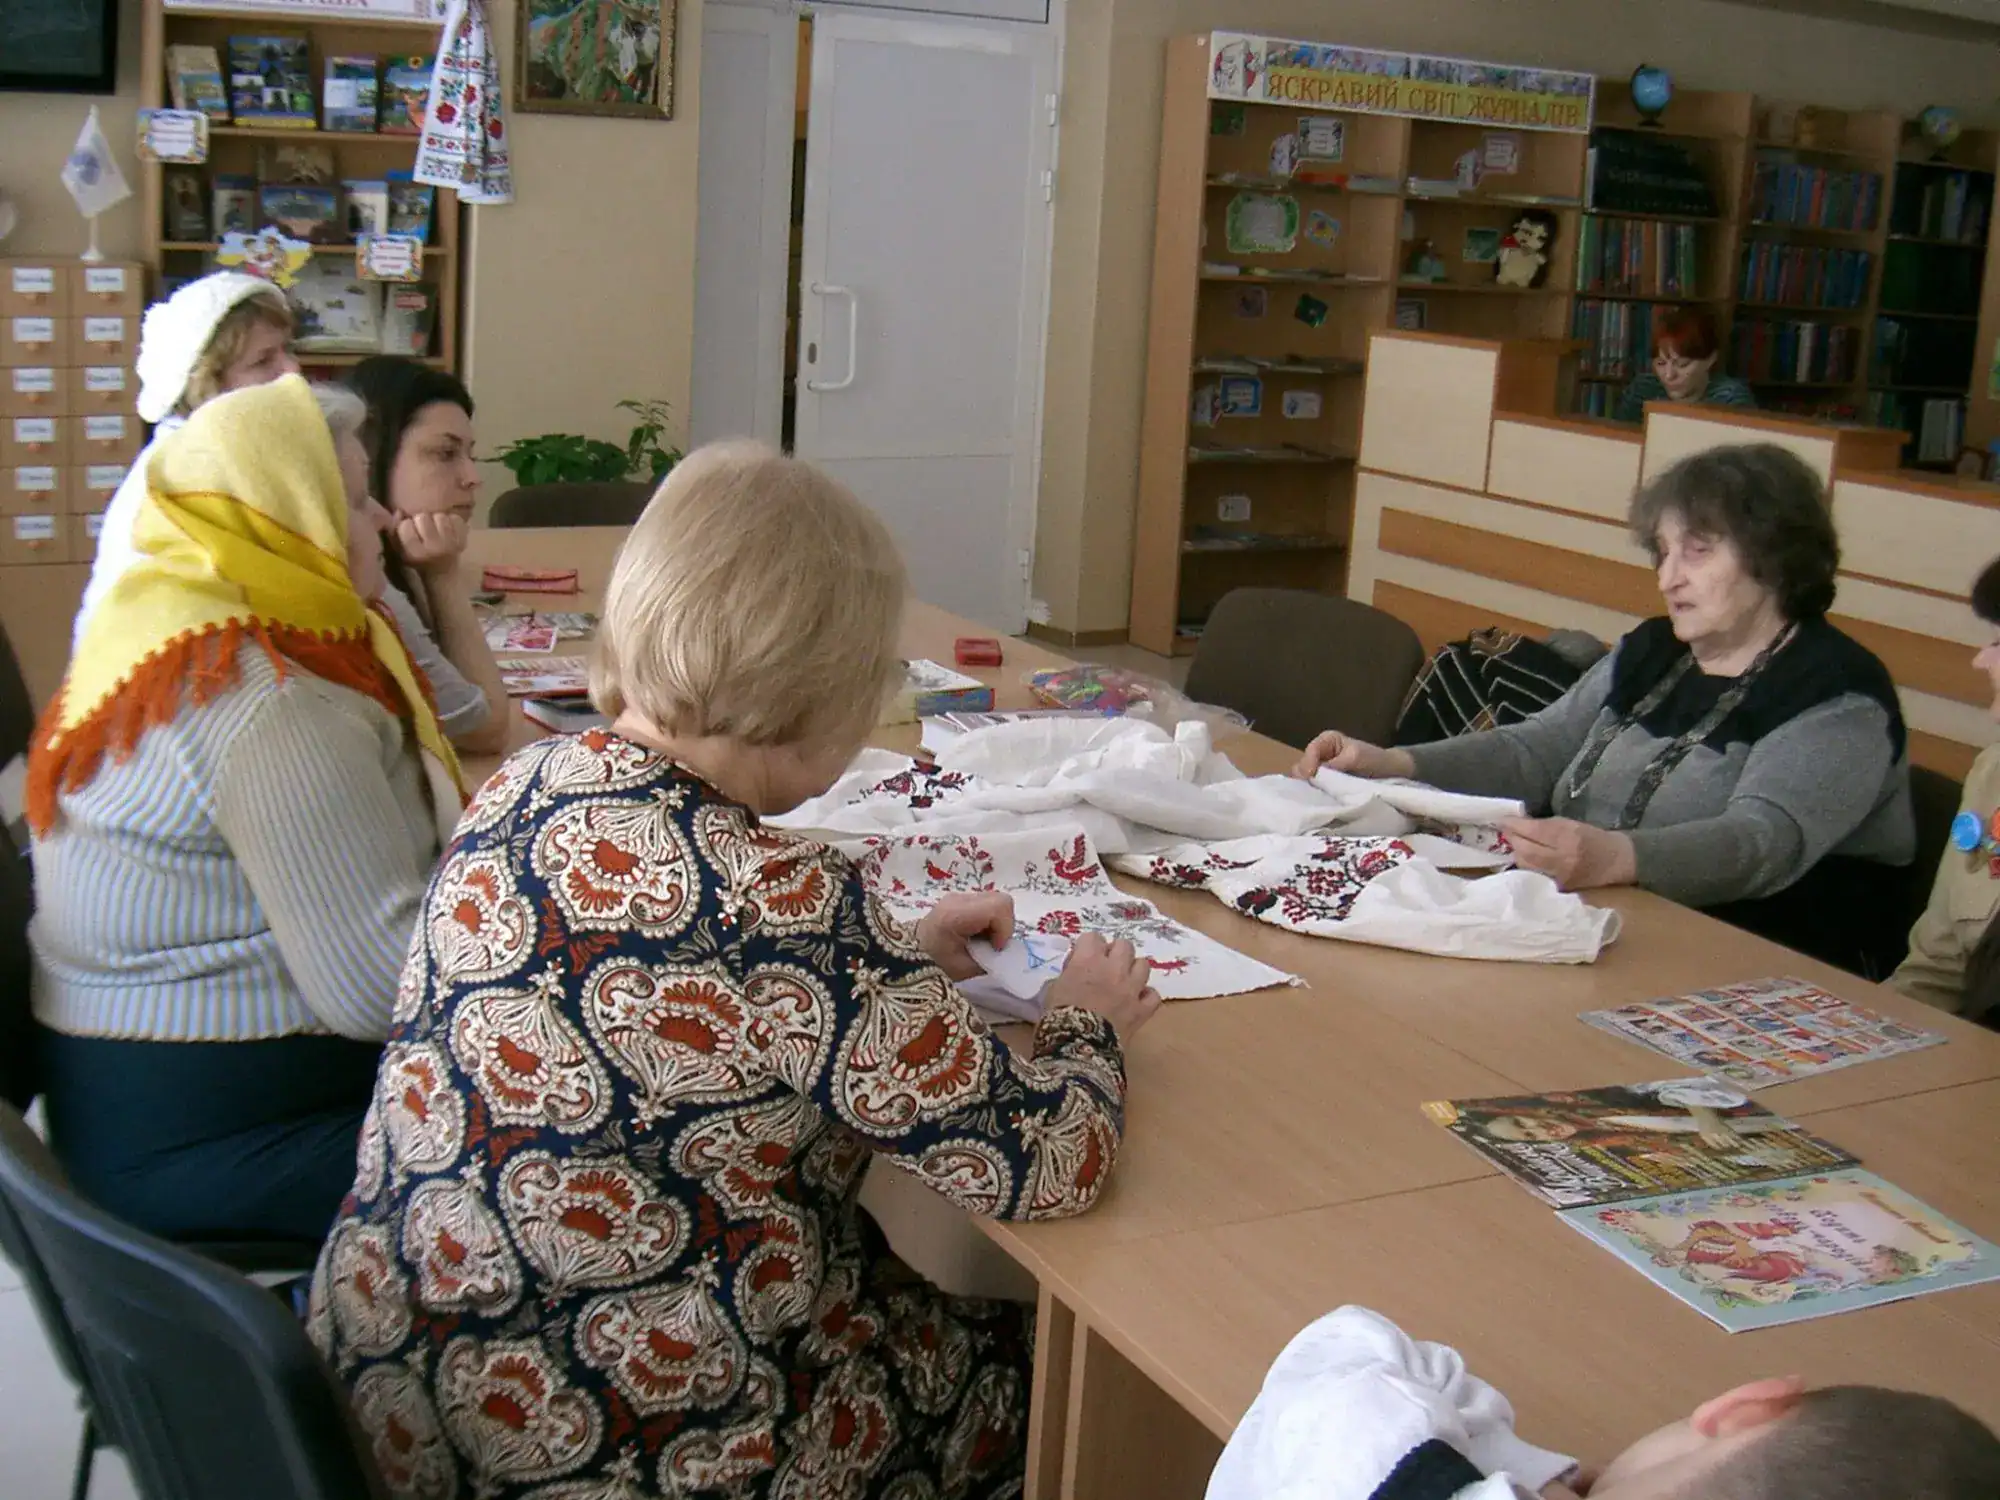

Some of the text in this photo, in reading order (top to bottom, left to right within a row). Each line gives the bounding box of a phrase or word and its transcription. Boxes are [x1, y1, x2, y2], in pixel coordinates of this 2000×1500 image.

[1267, 74, 1580, 127] ЯСКРАВИЙ СВІТ ЖУРНАЛІВ
